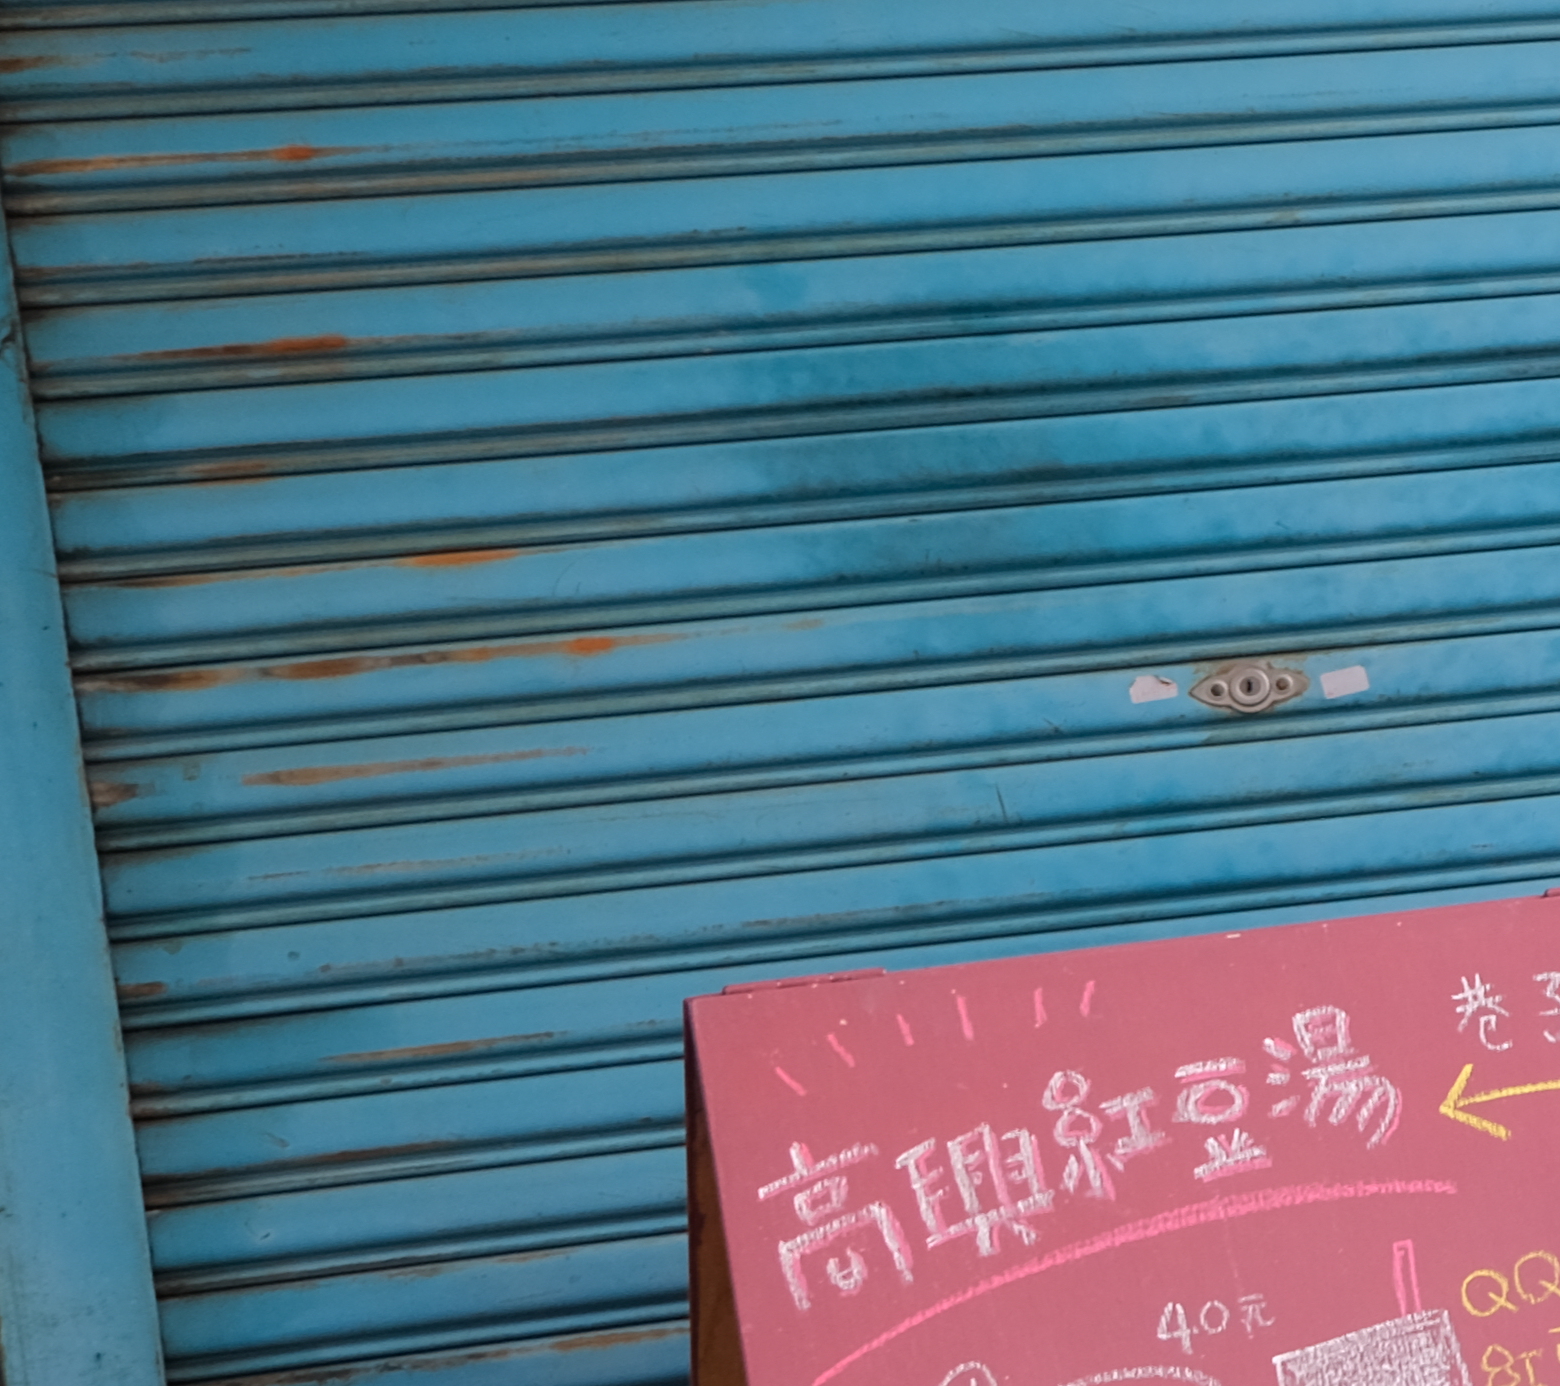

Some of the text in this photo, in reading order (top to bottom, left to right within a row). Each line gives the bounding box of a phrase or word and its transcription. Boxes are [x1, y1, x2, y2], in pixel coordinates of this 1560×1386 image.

[758, 1005, 1403, 1310] 高興紅豆湯
[1156, 1293, 1275, 1355] 40元
